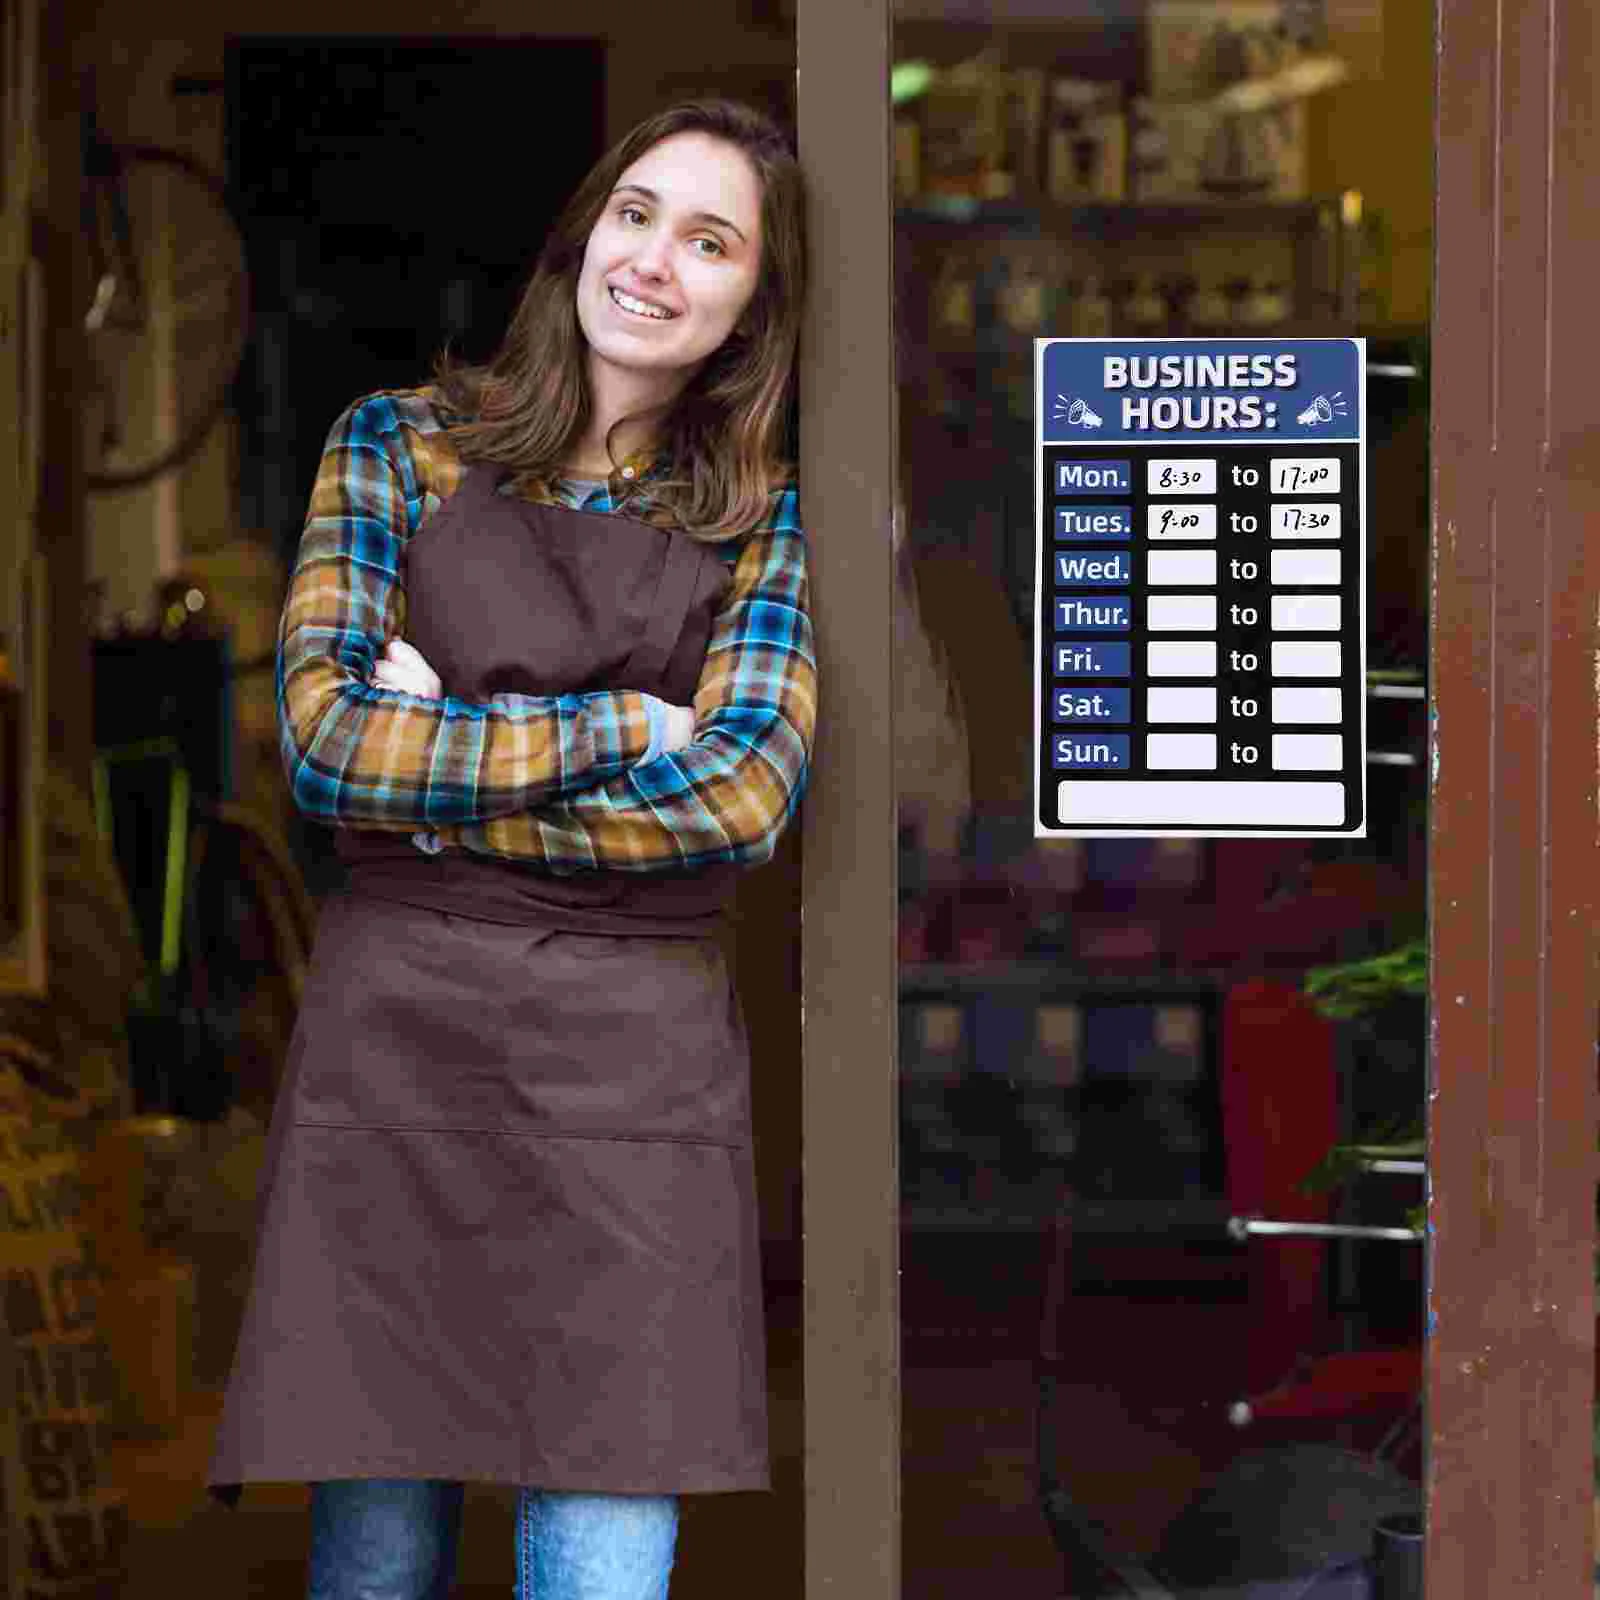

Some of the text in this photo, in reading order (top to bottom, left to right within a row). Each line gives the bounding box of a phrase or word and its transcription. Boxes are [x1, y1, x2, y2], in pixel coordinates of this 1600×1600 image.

[1103, 354, 1297, 388] BUSINESS
[1122, 395, 1277, 430] HOURS:
[1060, 465, 1329, 490] Mon. 8:30 to 17:00
[1059, 509, 1330, 534] Tues. 9:00 to 17:30
[1059, 555, 1258, 580] Wed. to
[1059, 601, 1258, 625] Thur. to
[1059, 647, 1258, 671] Fri. to
[1058, 693, 1258, 717] Sat. to
[1057, 740, 1258, 764] Sun. to
